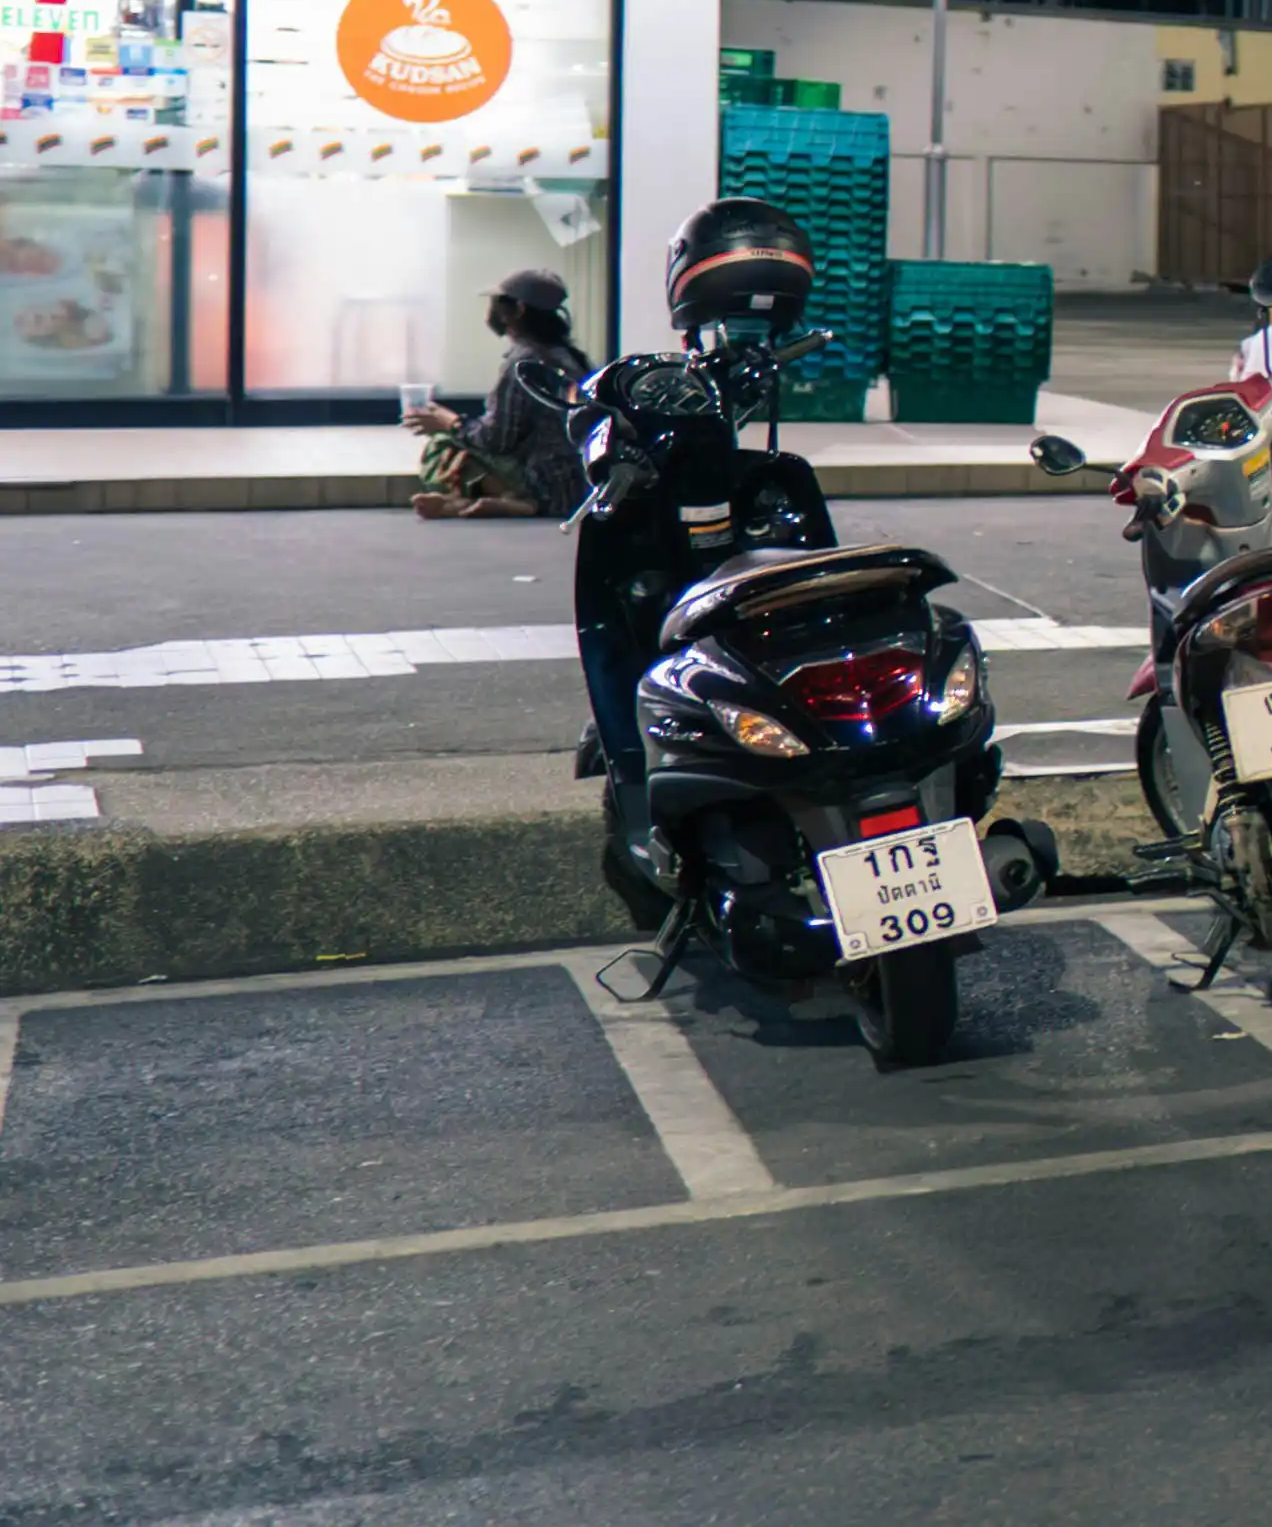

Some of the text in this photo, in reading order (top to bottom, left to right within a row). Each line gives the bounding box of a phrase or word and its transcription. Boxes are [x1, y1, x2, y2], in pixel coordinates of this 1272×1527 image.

[876, 872, 942, 904] ปัตตานี
[879, 901, 955, 942] 309
